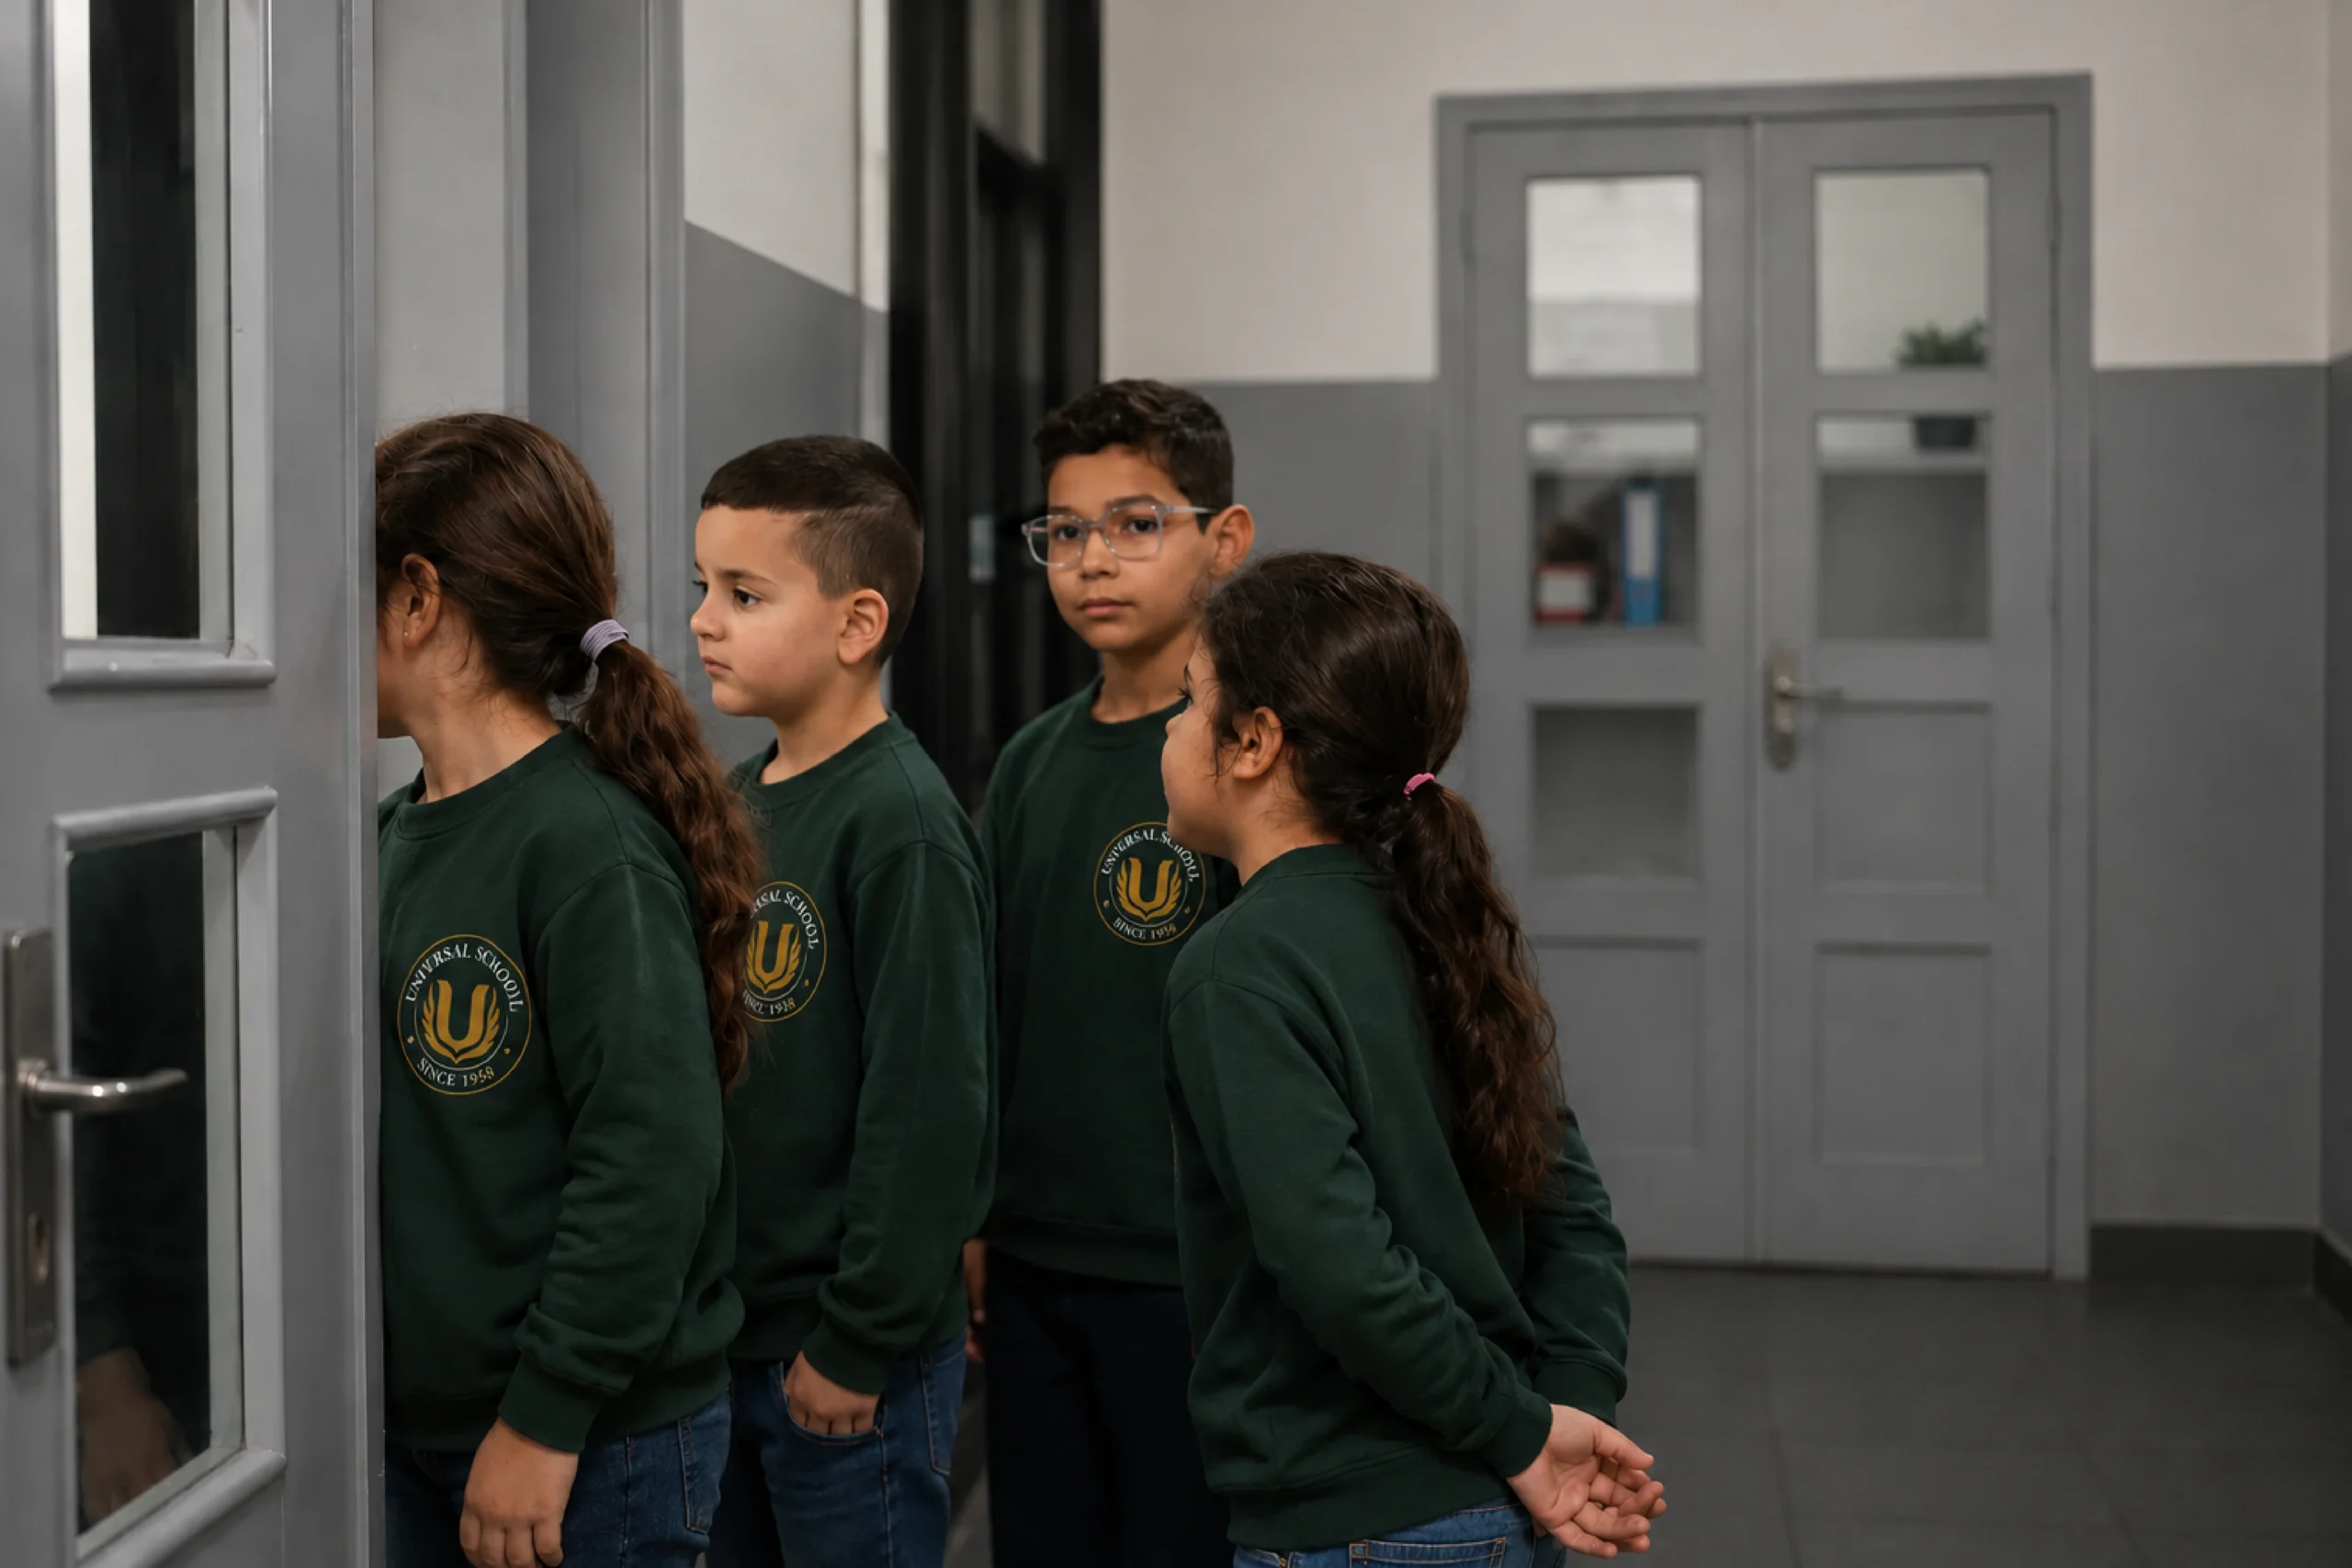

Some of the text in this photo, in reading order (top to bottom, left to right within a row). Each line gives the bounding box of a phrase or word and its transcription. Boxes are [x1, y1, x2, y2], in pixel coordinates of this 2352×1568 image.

[1128, 857, 1174, 912] U
[754, 920, 795, 985] U
[436, 979, 490, 1054] U
[416, 1057, 457, 1087] SINCE
